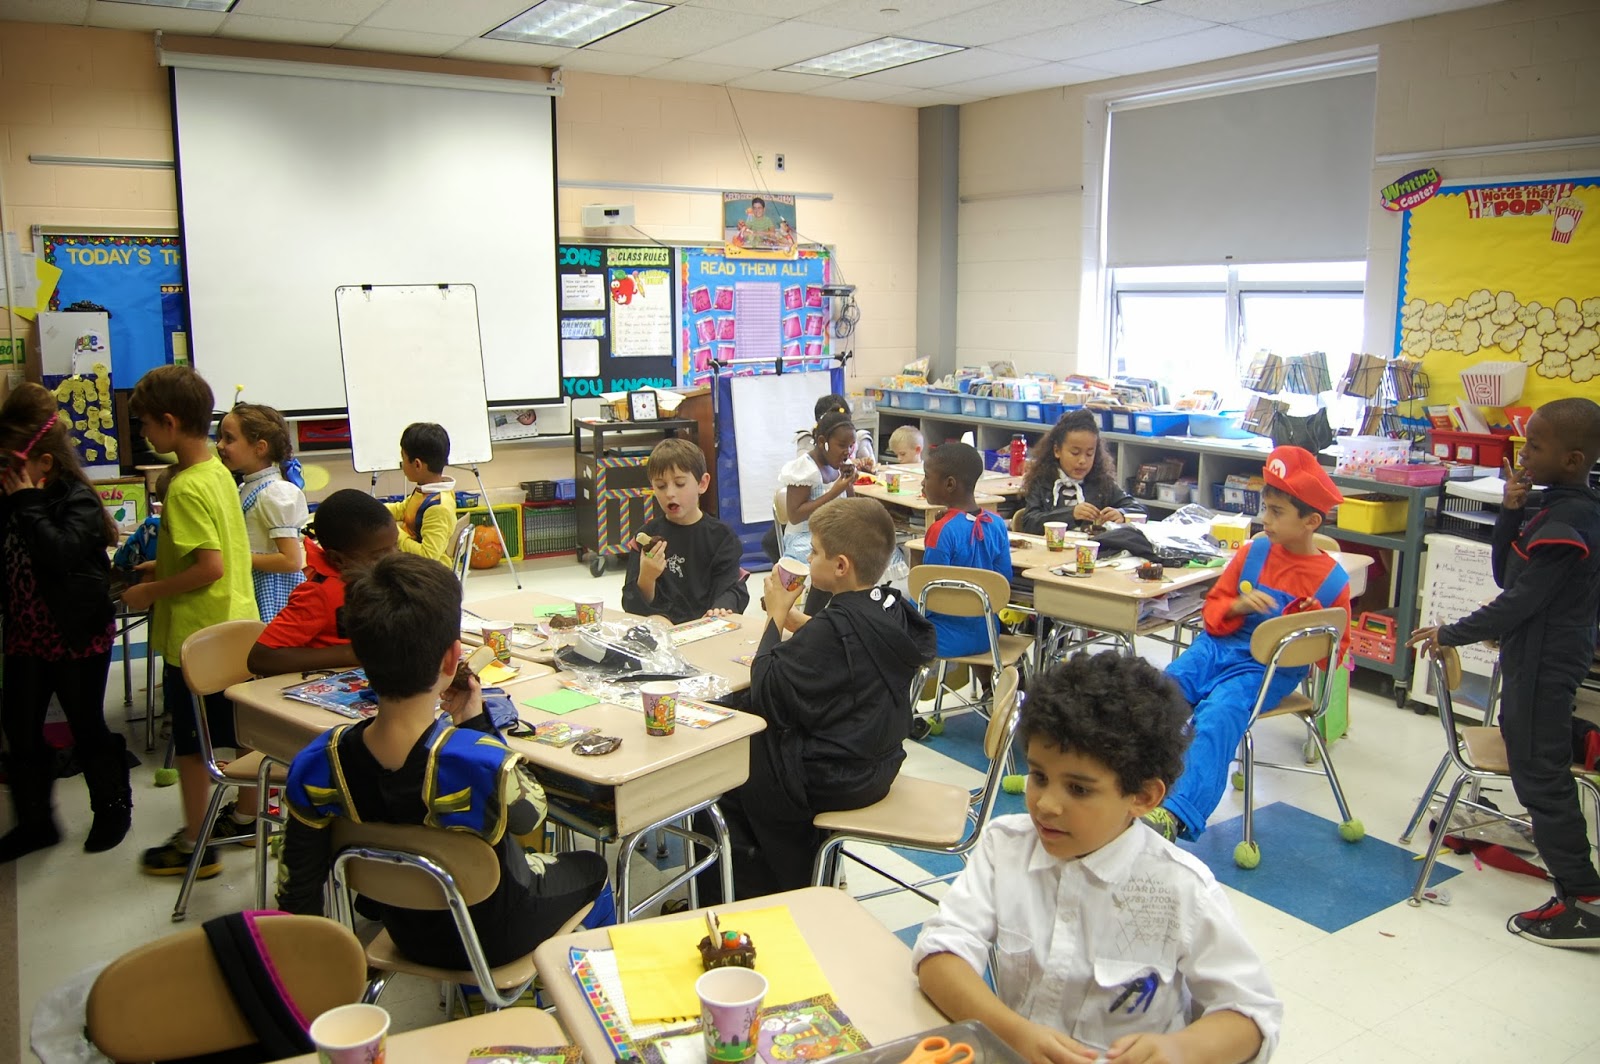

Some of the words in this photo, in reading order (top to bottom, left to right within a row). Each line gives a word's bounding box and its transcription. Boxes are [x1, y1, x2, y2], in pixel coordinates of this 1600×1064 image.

[1381, 167, 1438, 201] Writing
[1399, 184, 1435, 208] Center
[1481, 189, 1522, 202] Words
[1525, 187, 1556, 200] that
[1493, 199, 1542, 217] POP
[66, 248, 152, 265] TODAY'S
[617, 252, 642, 262] CLASS
[643, 252, 667, 262] RULES
[700, 261, 735, 275] READ
[739, 262, 777, 276] THEM
[781, 263, 808, 276] ALL!
[563, 377, 604, 396] YOU
[1270, 464, 1281, 476] M
